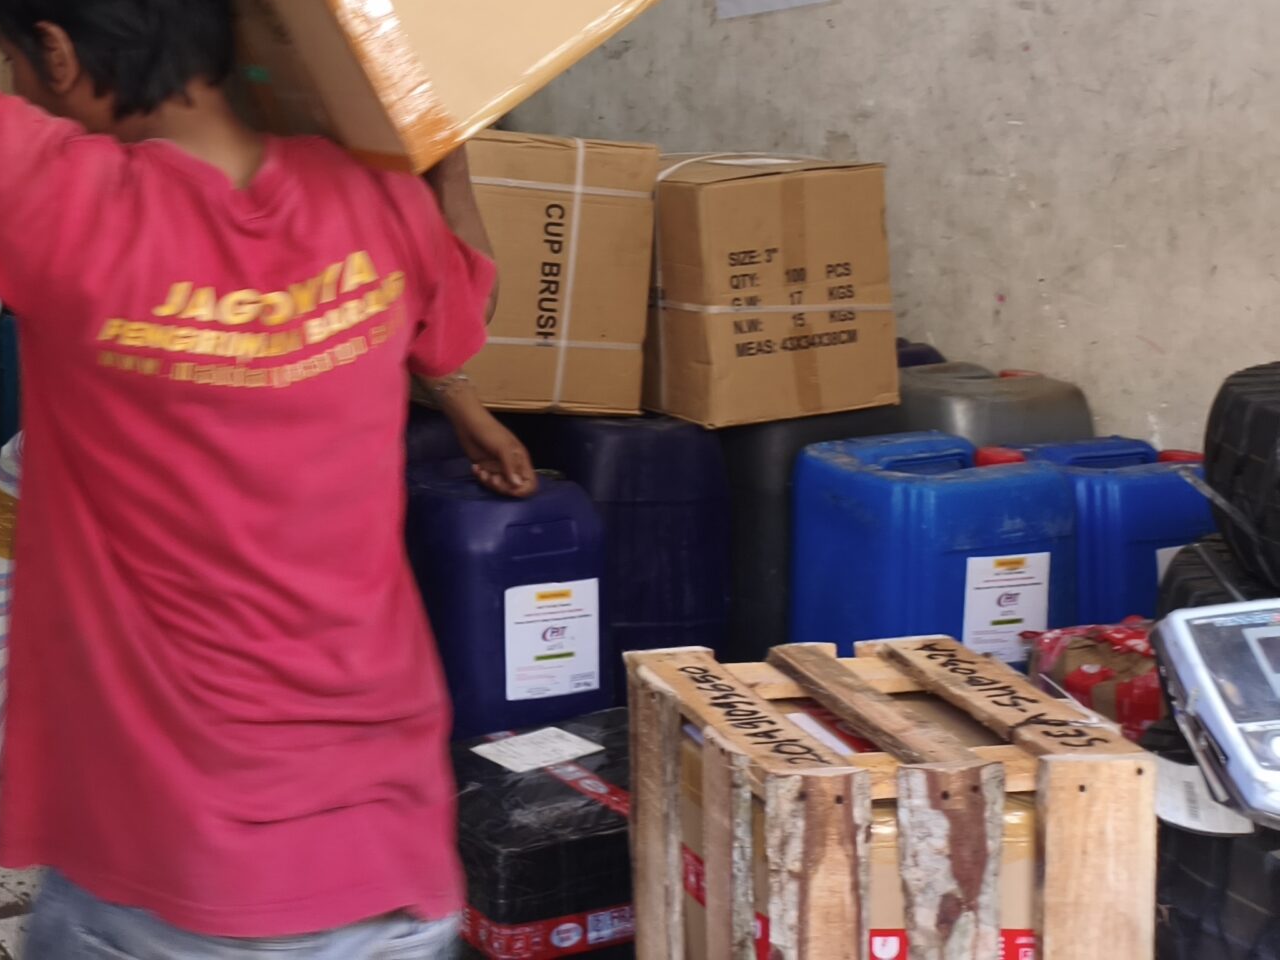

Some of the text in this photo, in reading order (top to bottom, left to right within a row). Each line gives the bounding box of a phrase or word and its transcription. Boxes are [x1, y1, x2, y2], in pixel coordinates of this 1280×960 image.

[728, 249, 761, 267] SIZE:
[535, 203, 565, 347] CUP BRUSH
[729, 262, 852, 290] QTY: 100 PCS
[789, 290, 803, 306] 17
[827, 284, 855, 301] KGS
[829, 309, 856, 323] KGS
[735, 339, 777, 358] MEAS:
